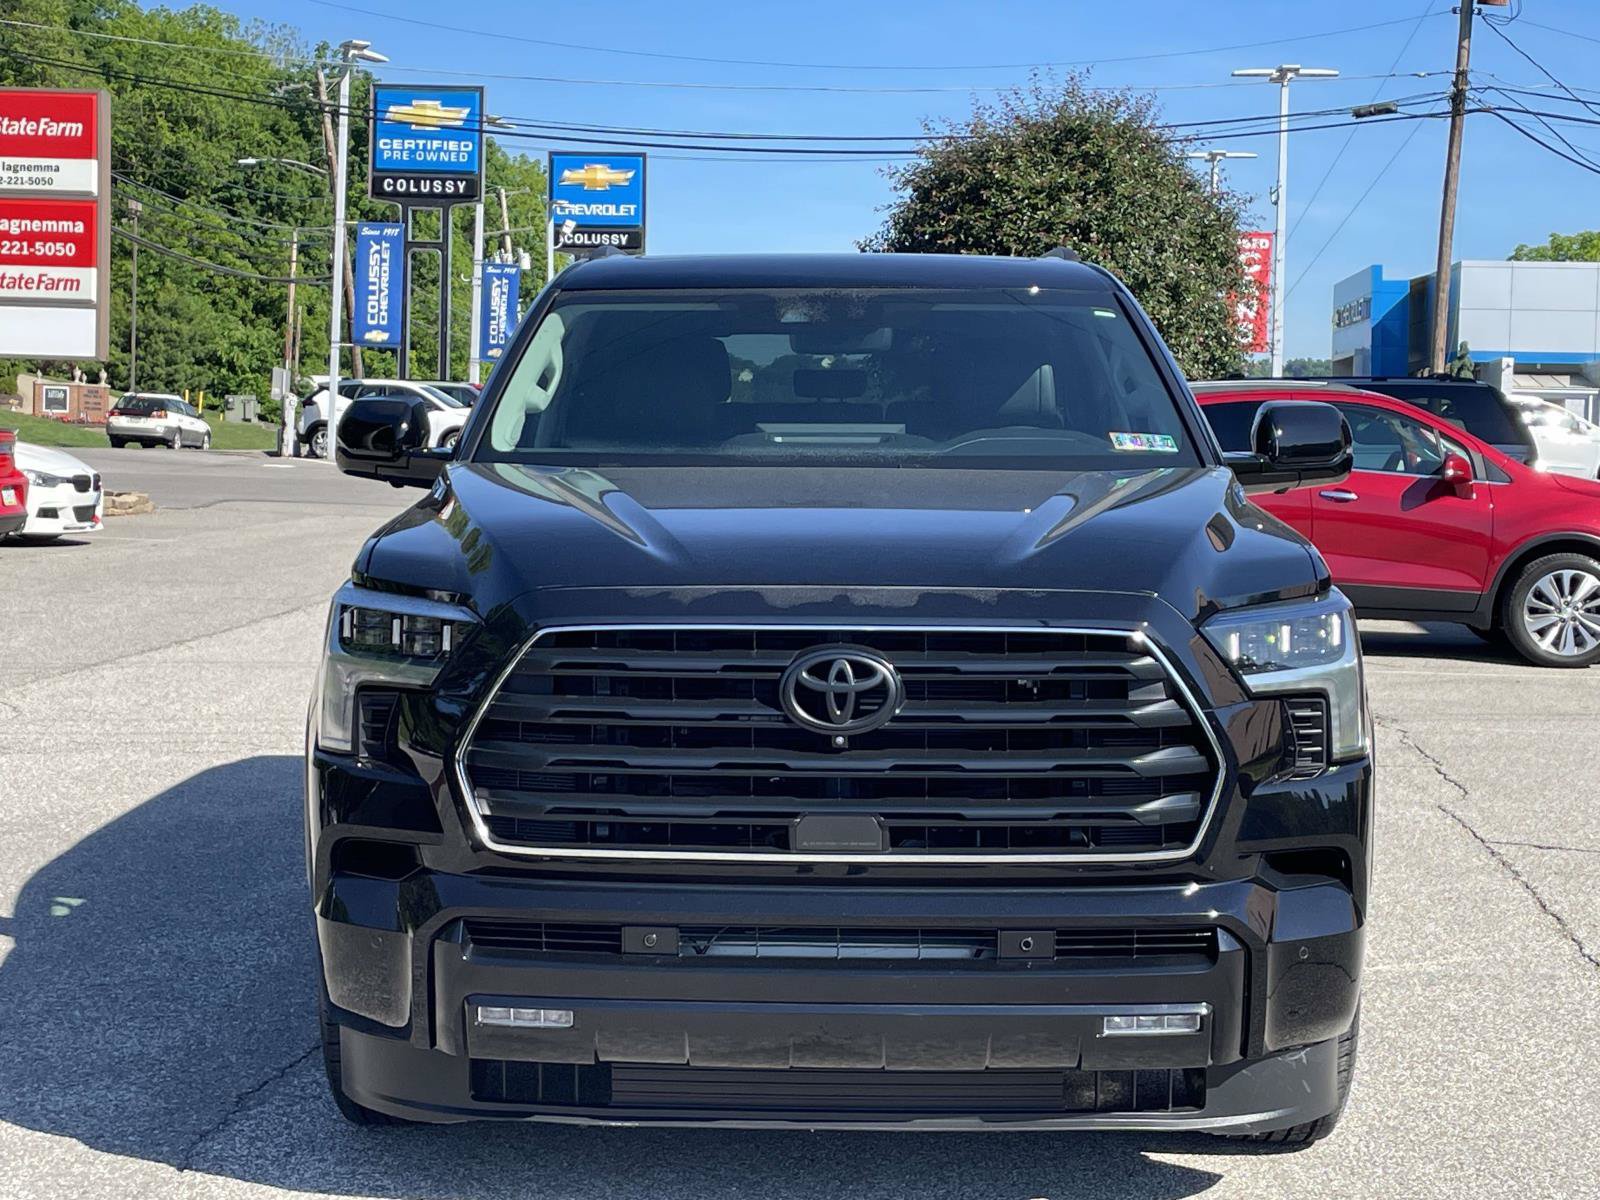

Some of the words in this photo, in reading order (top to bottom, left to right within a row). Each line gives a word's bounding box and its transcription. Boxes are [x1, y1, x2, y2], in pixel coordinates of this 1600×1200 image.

[0, 117, 83, 137] tateFarm
[379, 138, 473, 151] CERTIFIED
[383, 150, 468, 162] PRE-OWNED
[383, 178, 466, 193] COLUSSY
[0, 218, 84, 235] agnemma
[0, 240, 76, 257] 221-5050
[564, 233, 629, 246] COLUSSY
[0, 272, 81, 291] tateFarm
[367, 240, 381, 326] COLUSSY
[379, 240, 391, 326] CHEVROLET
[489, 276, 502, 345] COLUSSY
[499, 276, 509, 345] CHEVROLET
